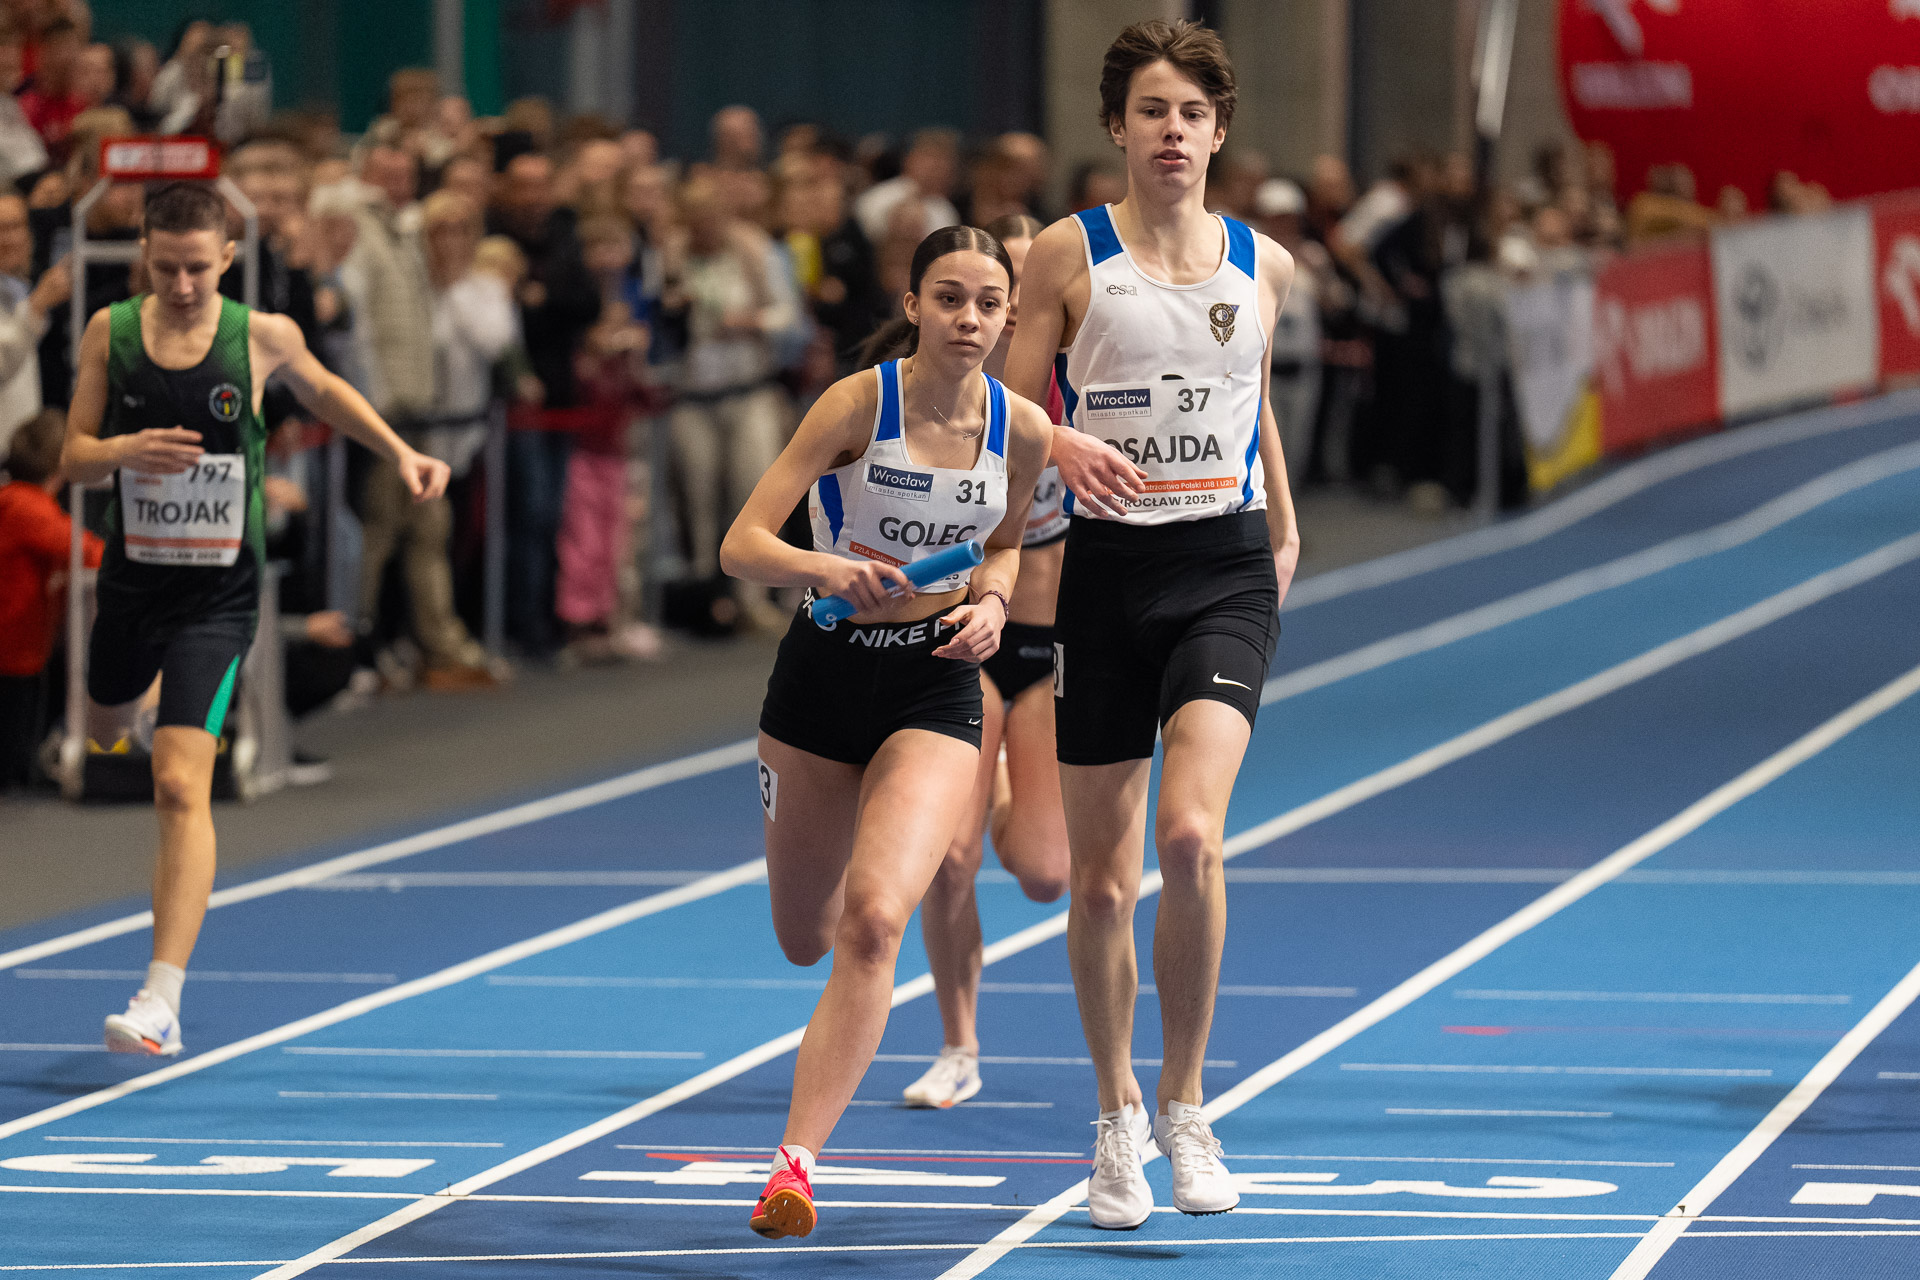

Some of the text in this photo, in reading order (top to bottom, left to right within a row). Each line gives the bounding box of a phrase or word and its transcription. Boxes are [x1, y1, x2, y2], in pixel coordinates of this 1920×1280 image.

[1090, 392, 1148, 407] Wrocław
[1177, 388, 1211, 413] 37
[189, 462, 233, 484] 797
[873, 467, 930, 488] Wrocław
[868, 486, 895, 495] miasto
[955, 479, 987, 505] 31
[1144, 483, 1180, 492] strzostwa
[1180, 481, 1202, 490] Polski
[1220, 479, 1235, 487] U20
[134, 498, 231, 525] TROJAK
[1119, 494, 1216, 508] ROCŁAW 2025
[879, 516, 978, 548] GOLEC
[848, 622, 928, 648] NIKE
[759, 764, 771, 809] 3
